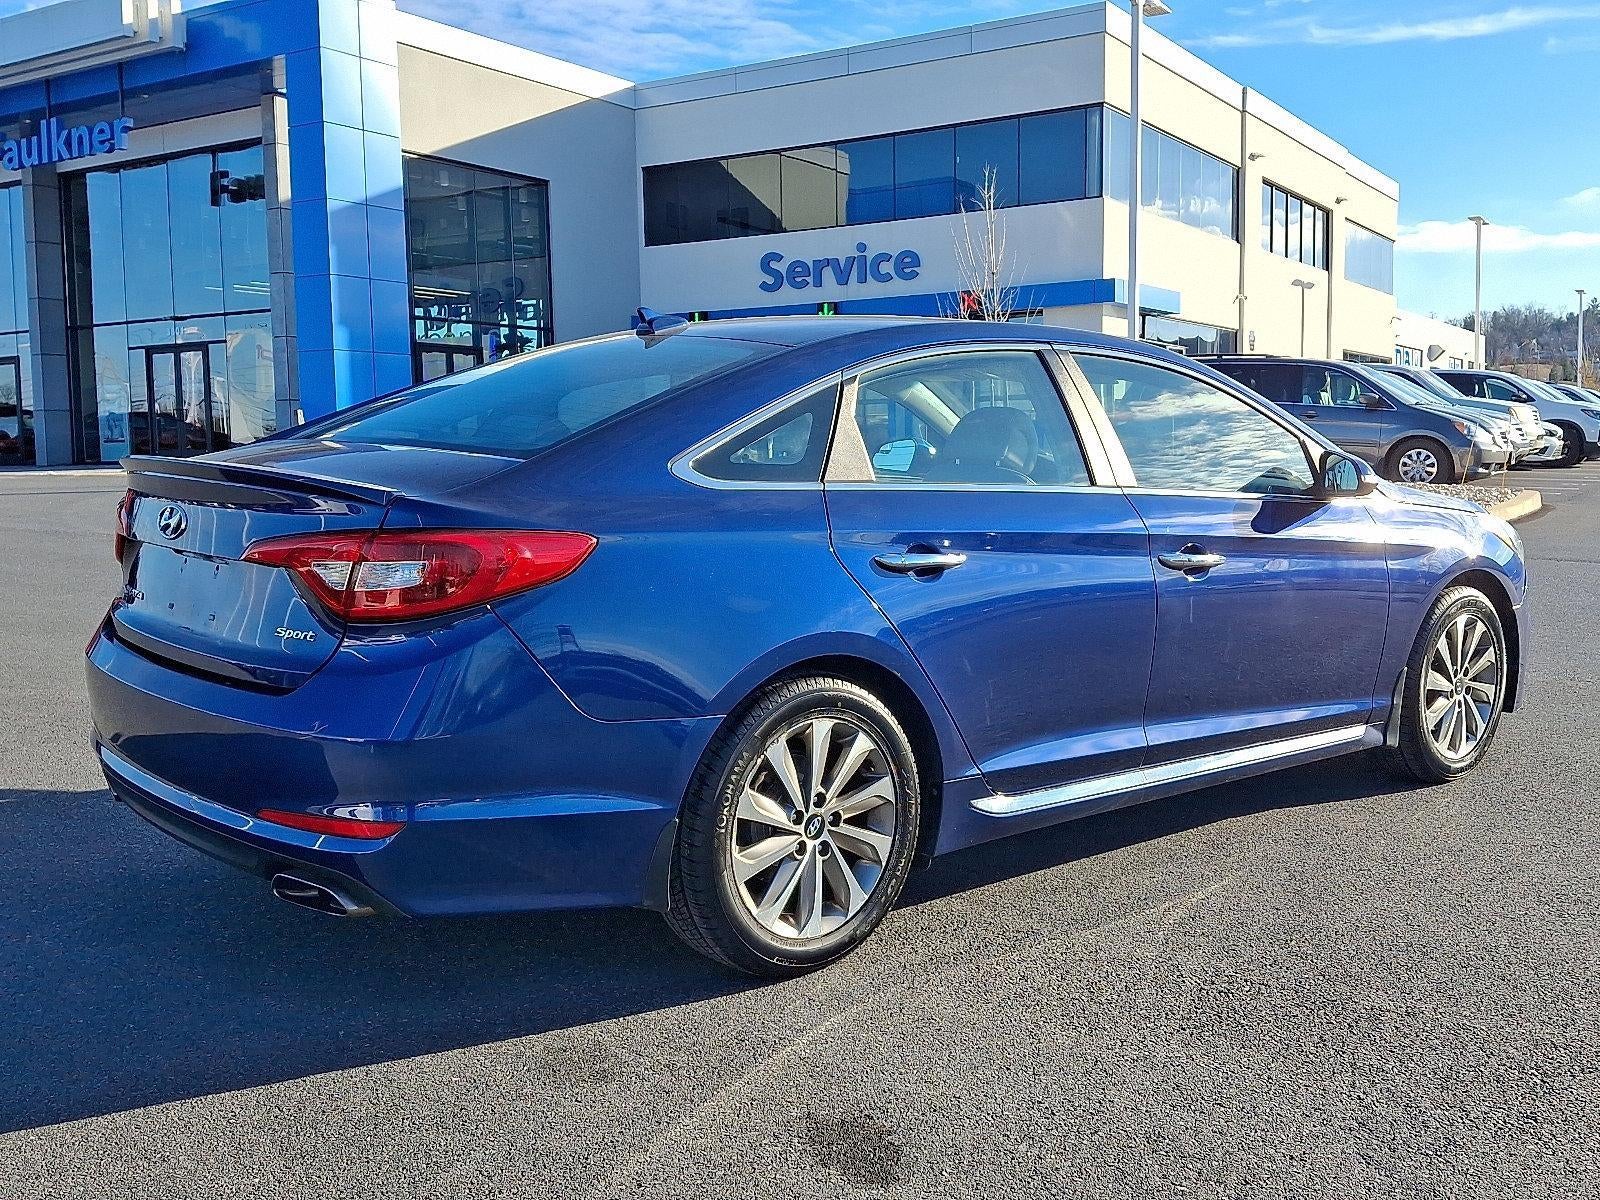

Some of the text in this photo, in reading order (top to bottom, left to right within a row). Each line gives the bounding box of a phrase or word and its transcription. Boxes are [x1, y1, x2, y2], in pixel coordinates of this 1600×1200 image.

[0, 117, 133, 171] aulkner
[758, 242, 921, 293] Service
[274, 627, 315, 641] Sport
[715, 751, 752, 833] YOKOHAMA
